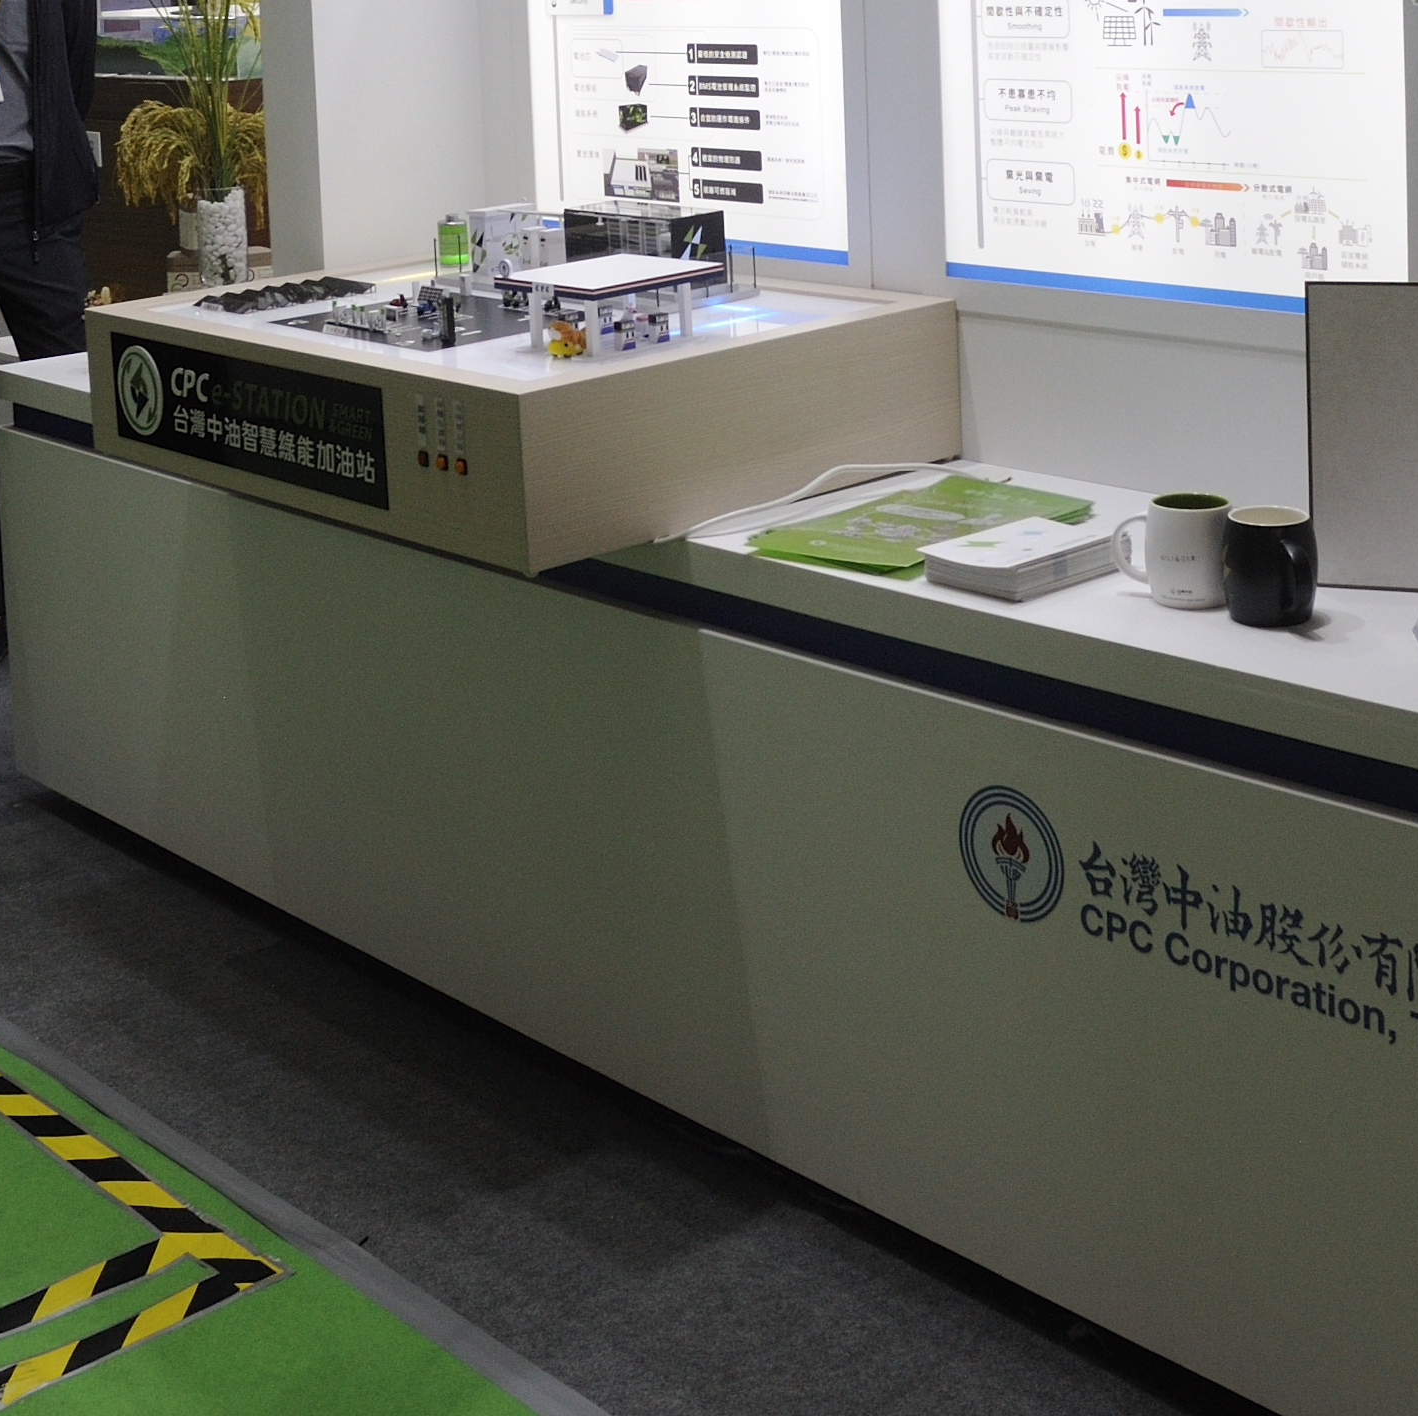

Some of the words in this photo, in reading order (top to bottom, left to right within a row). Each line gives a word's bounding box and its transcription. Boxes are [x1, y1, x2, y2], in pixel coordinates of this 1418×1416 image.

[986, 5, 1064, 18] 間歇性與不確定性
[1007, 22, 1043, 32] Smoothing
[1274, 16, 1328, 28] 間歇性輸出
[689, 49, 694, 60] 1
[689, 80, 695, 91] 2
[1004, 104, 1021, 112] Peak
[1023, 105, 1050, 115] Shaving
[690, 112, 696, 124] 3
[692, 152, 698, 163] 4
[1018, 186, 1042, 196] Saving
[170, 366, 211, 403] CPC
[211, 379, 327, 431] e-STATION
[173, 404, 377, 485] 台灣中油智慧綠能加油站
[1081, 902, 1154, 955] CPC
[1164, 931, 1398, 1046] Corporation,
